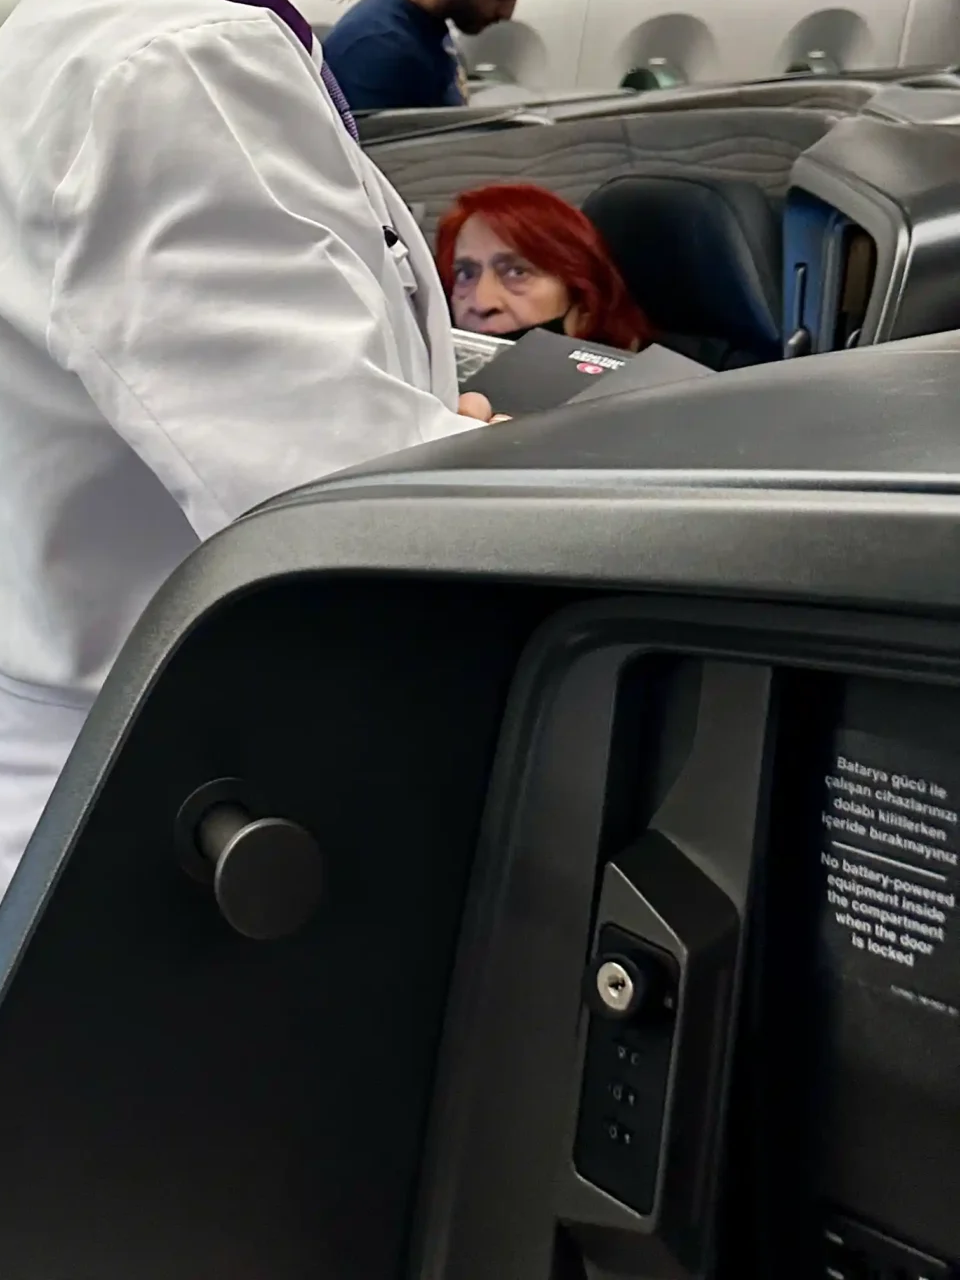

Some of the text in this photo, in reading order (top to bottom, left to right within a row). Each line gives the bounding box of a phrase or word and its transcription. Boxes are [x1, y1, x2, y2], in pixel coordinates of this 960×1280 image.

[824, 774, 958, 825] çalışan cihazlarınızı
[836, 755, 948, 800] Batarya gücü ile
[832, 796, 948, 842] dolabı kilitlerken
[820, 851, 956, 908] No battery-powered
[826, 873, 946, 924] equipment inside
[827, 889, 945, 942] the compartment
[835, 910, 936, 956] when the door
[851, 932, 915, 967] is locked
